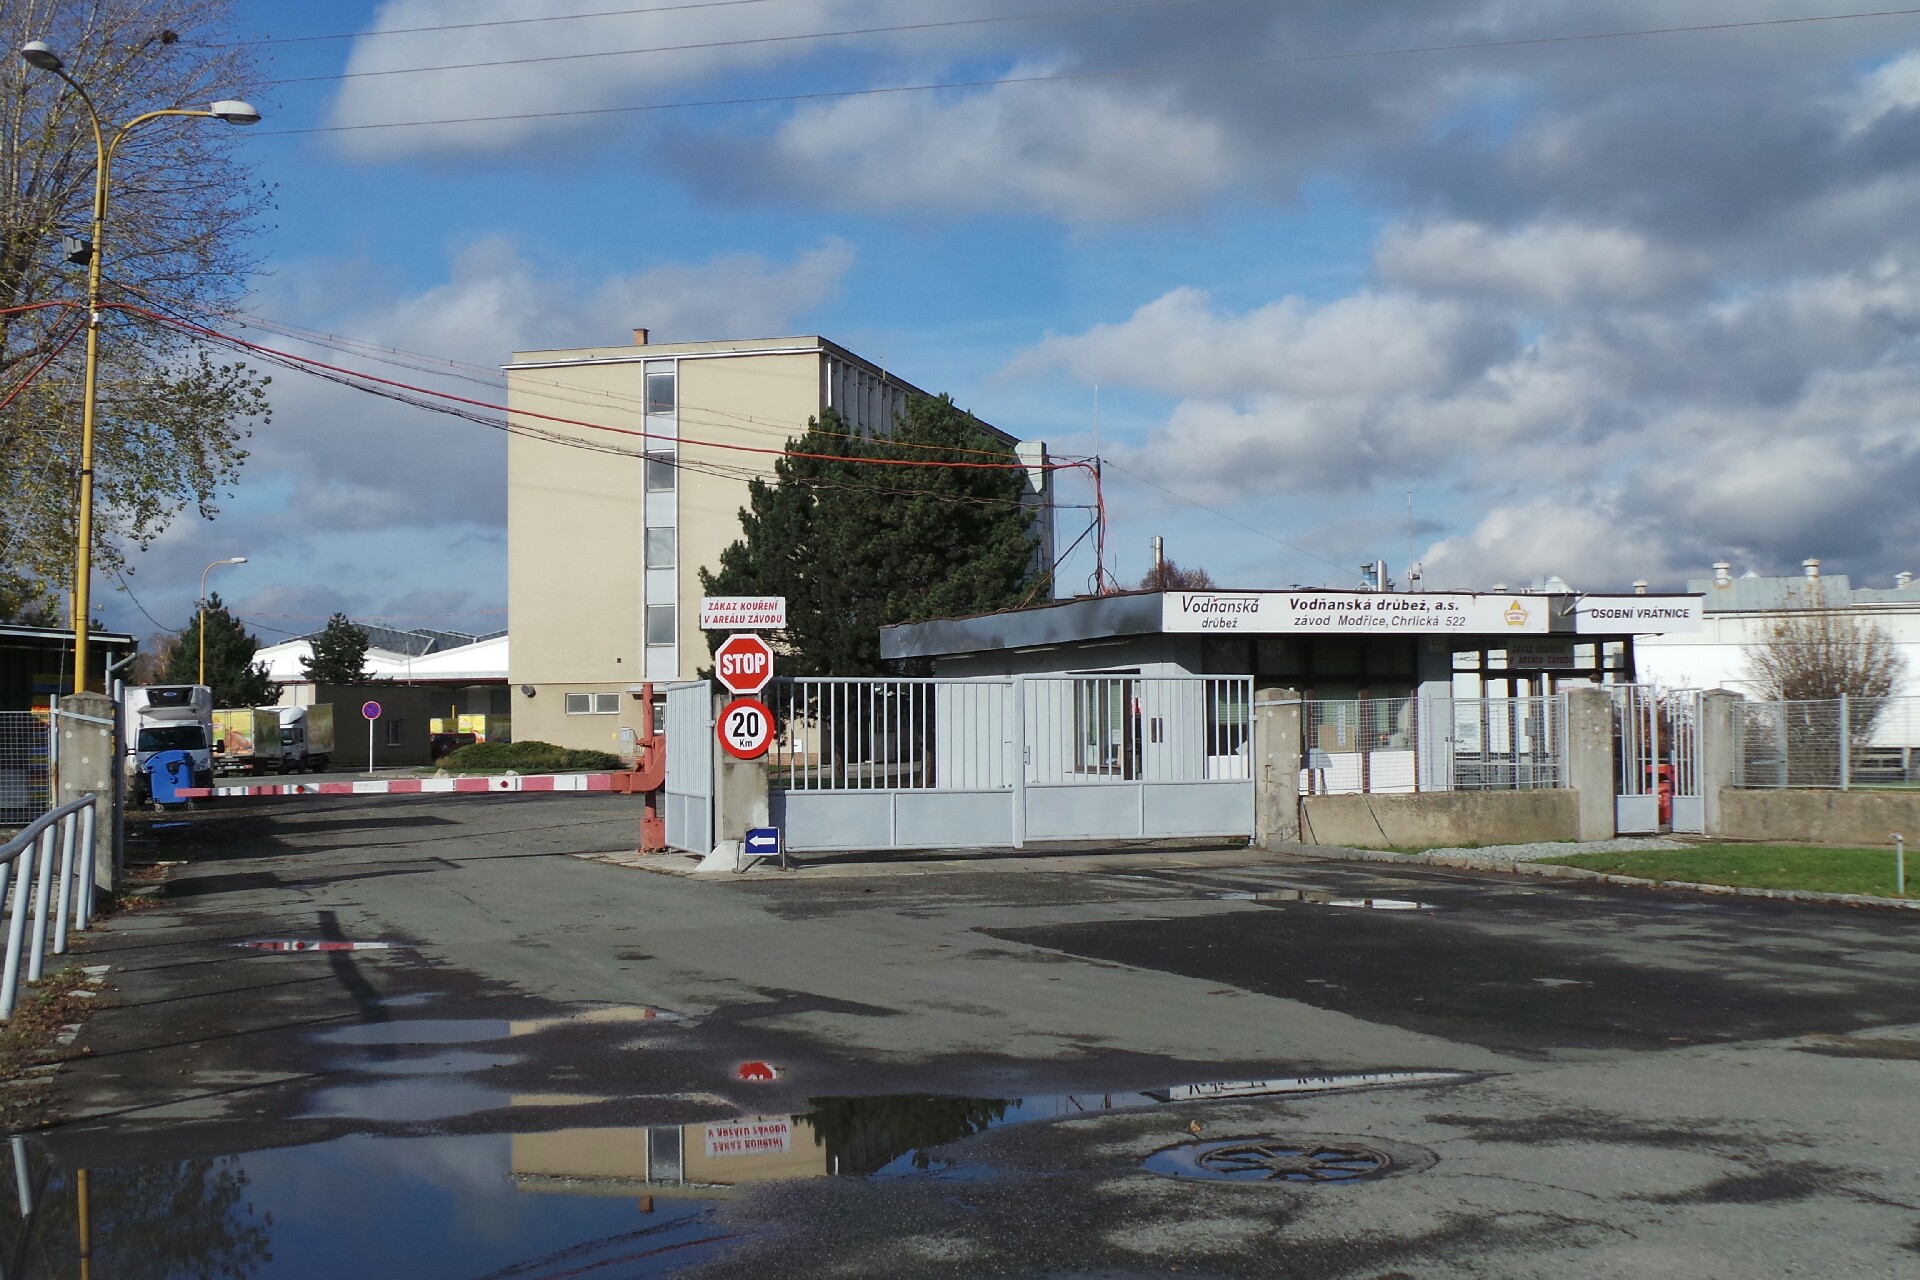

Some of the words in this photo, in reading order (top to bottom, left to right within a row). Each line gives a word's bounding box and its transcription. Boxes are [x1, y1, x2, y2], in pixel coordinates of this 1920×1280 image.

[708, 600, 738, 611] ZÁKAZ
[740, 600, 779, 611] KOUŘENÍ
[1182, 595, 1260, 613] Vodňanská
[1290, 598, 1372, 611] Vodňanská
[1377, 598, 1430, 613] drůbež,
[1435, 601, 1459, 611] a.s.
[704, 615, 710, 623] V
[713, 613, 746, 624] AREÁLU
[748, 613, 783, 624] ZÁVODU
[1591, 606, 1635, 619] OSOBNÍ
[1637, 606, 1690, 618] VRÁTNICE
[1201, 617, 1238, 628] drůbež
[1294, 614, 1331, 626] závod
[1337, 615, 1389, 628] Modřice,
[1391, 615, 1439, 627] Chrlická
[1445, 616, 1466, 627] 522
[722, 653, 766, 675] STOP
[732, 712, 759, 738] 20
[739, 738, 753, 748] Km
